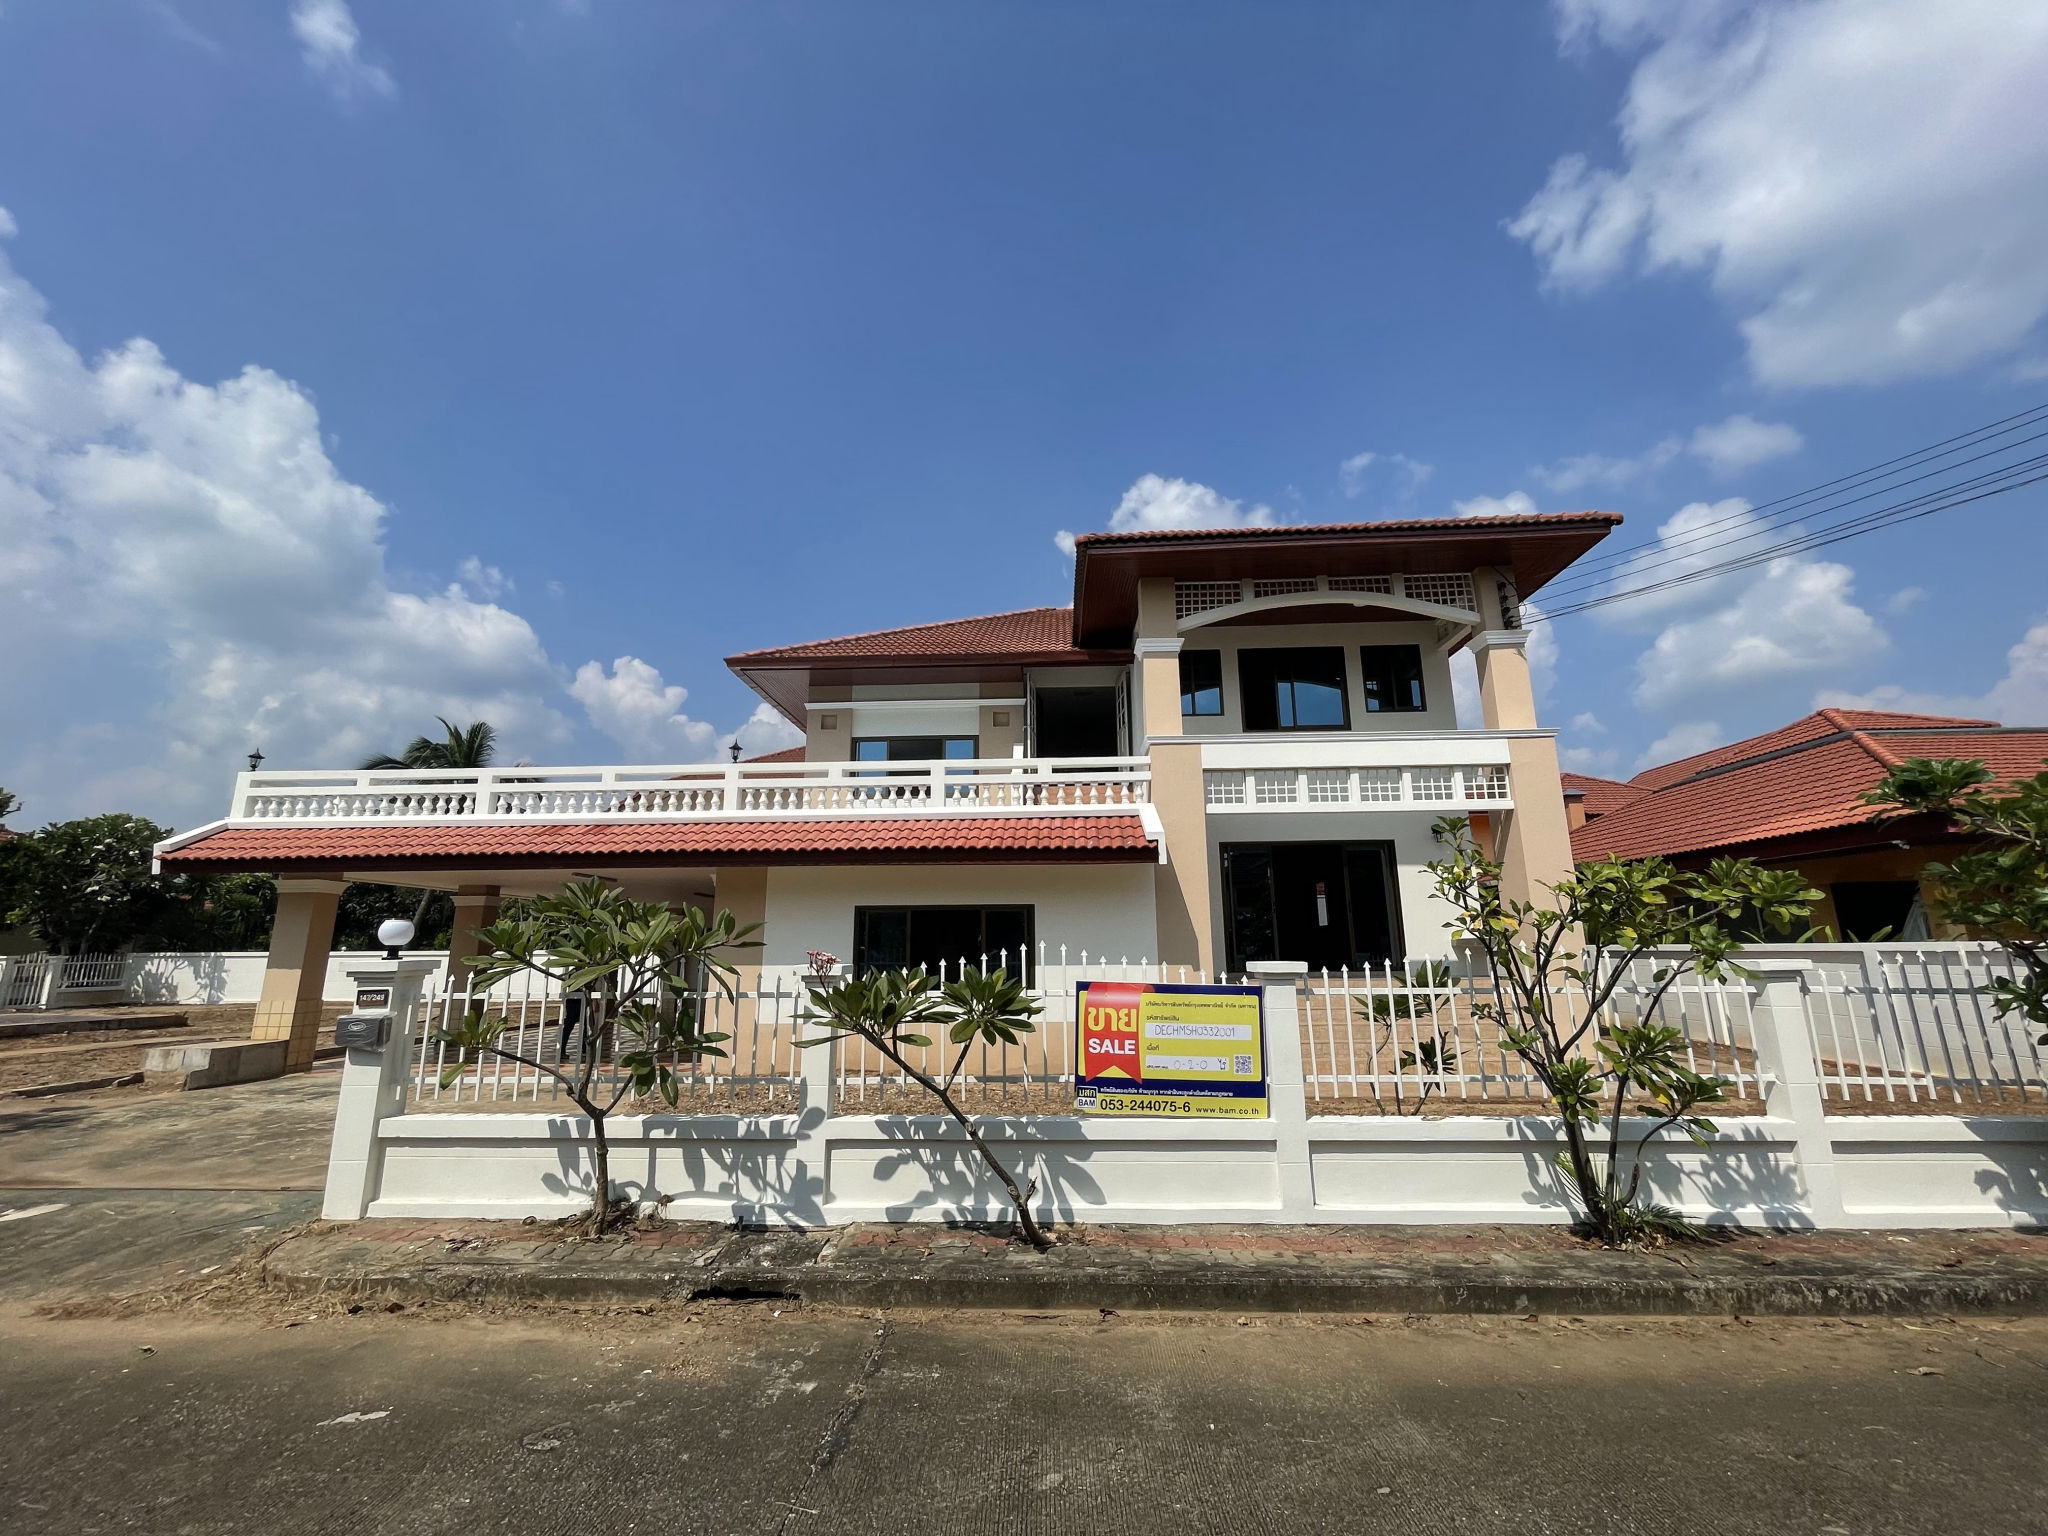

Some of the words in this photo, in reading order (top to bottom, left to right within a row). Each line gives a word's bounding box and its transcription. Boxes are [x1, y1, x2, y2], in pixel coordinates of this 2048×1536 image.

[1087, 1007, 1137, 1032] ขาย
[1088, 1038, 1136, 1055] SALE
[1078, 1098, 1096, 1107] BAM
[1100, 1098, 1191, 1113] 053-244075-6
[1195, 1107, 1259, 1115] www.bam.co.th
